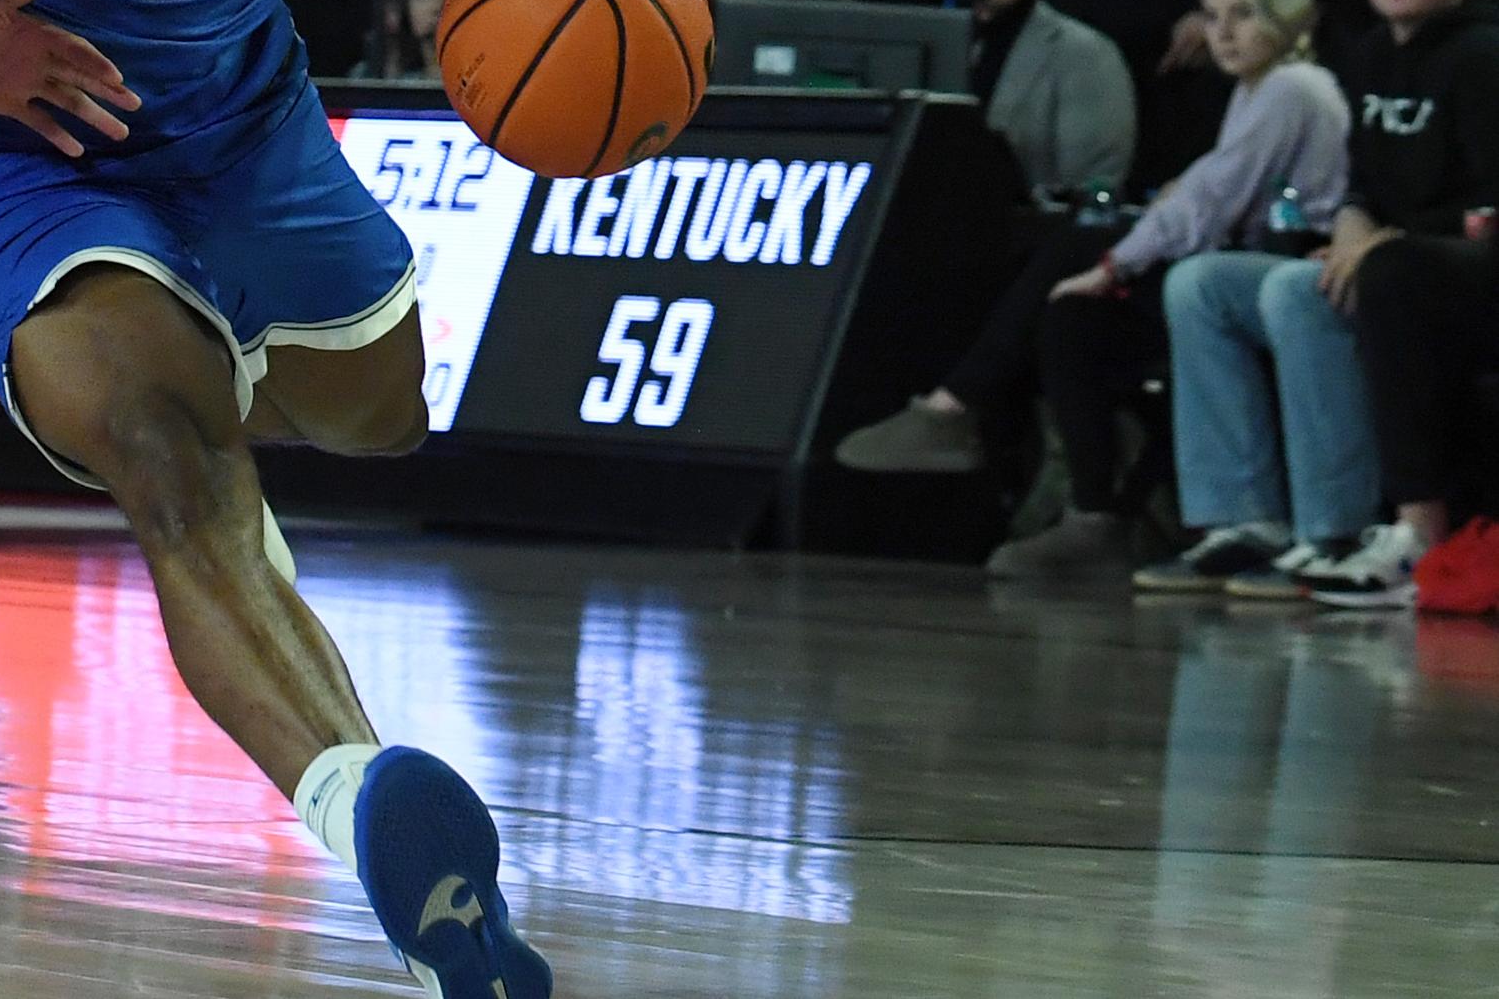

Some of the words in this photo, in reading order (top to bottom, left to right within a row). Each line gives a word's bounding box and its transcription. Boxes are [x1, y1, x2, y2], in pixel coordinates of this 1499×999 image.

[370, 138, 495, 211] 5:12
[531, 157, 873, 266] KENTUCKY
[579, 295, 715, 427] 59
